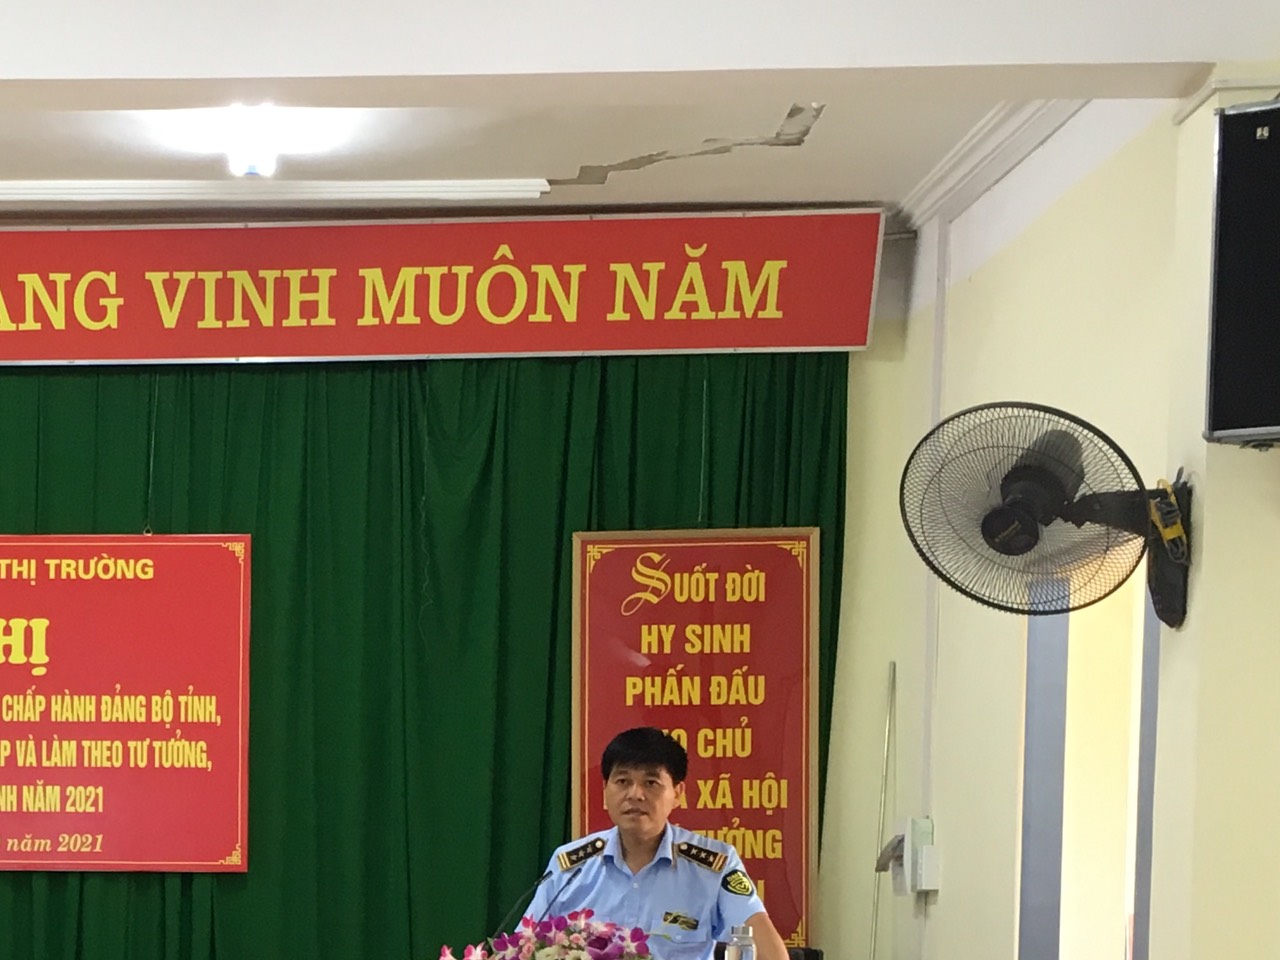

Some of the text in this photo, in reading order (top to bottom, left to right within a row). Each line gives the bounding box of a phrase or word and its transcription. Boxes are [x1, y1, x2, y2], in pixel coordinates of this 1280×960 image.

[144, 267, 336, 329] VINH
[357, 244, 586, 327] MUÔN
[606, 243, 787, 321] NĂM
[44, 554, 155, 581] TRƯỜNG
[621, 552, 765, 616] SUỐT ĐỜI
[641, 624, 751, 655] HY SINH
[2, 685, 46, 722] CHẤP
[51, 689, 96, 722] HÀNH
[101, 684, 146, 723] ĐẢNG
[151, 689, 173, 728] BỘ
[178, 685, 221, 726] TỈNH,
[625, 664, 766, 706] PHẤN ĐẤU
[16, 734, 37, 767] VÀ
[42, 734, 76, 767] LÀM
[82, 741, 123, 768] THEO
[128, 738, 150, 768] TƯ
[153, 729, 212, 772] TƯỞNG,
[697, 716, 752, 758] CHỦ
[22, 779, 61, 812] NĂM
[65, 786, 104, 813] 2021
[696, 773, 734, 810] XÃ
[742, 772, 788, 815] HỘI
[6, 836, 53, 853] năm
[57, 834, 104, 852] 2021
